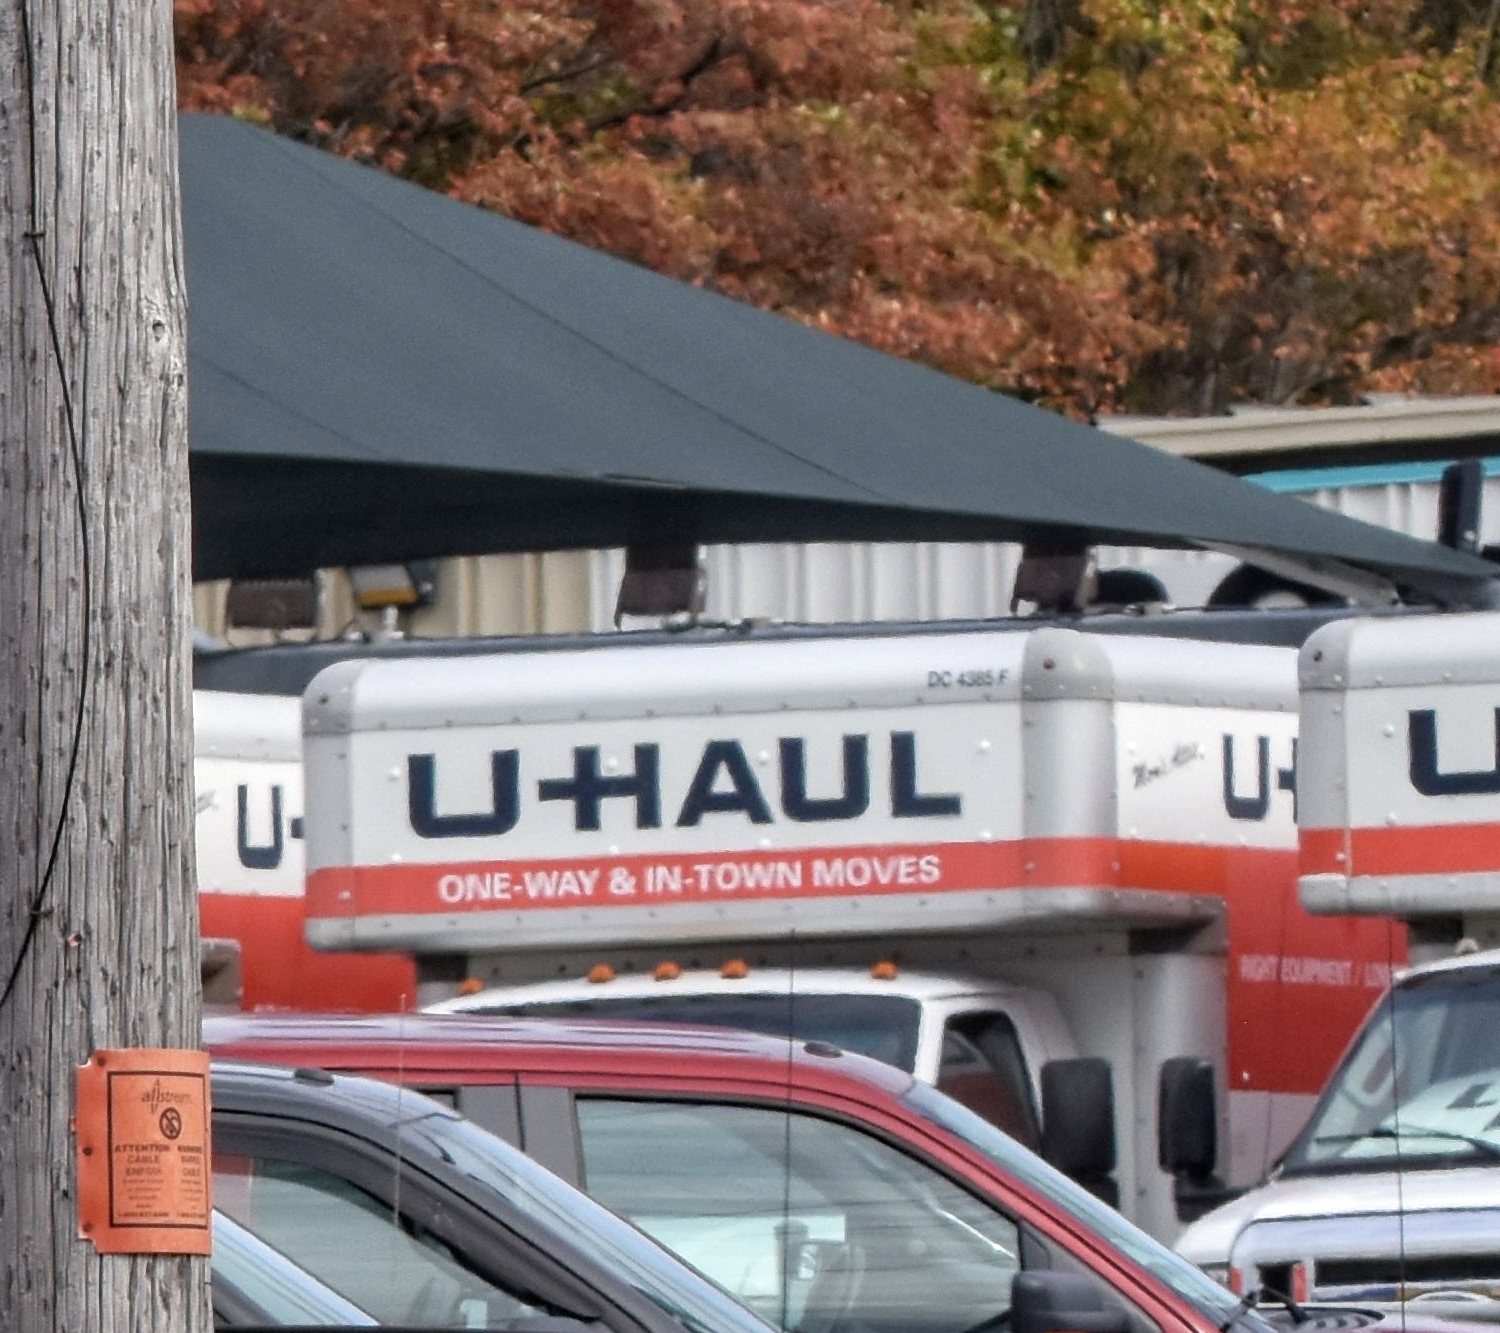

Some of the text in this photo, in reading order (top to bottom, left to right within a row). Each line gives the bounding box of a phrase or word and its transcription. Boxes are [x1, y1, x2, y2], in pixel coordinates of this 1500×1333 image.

[406, 729, 964, 840] U-HAUL
[437, 854, 941, 904] ONE-WAY & IN-TOWN MOVES
